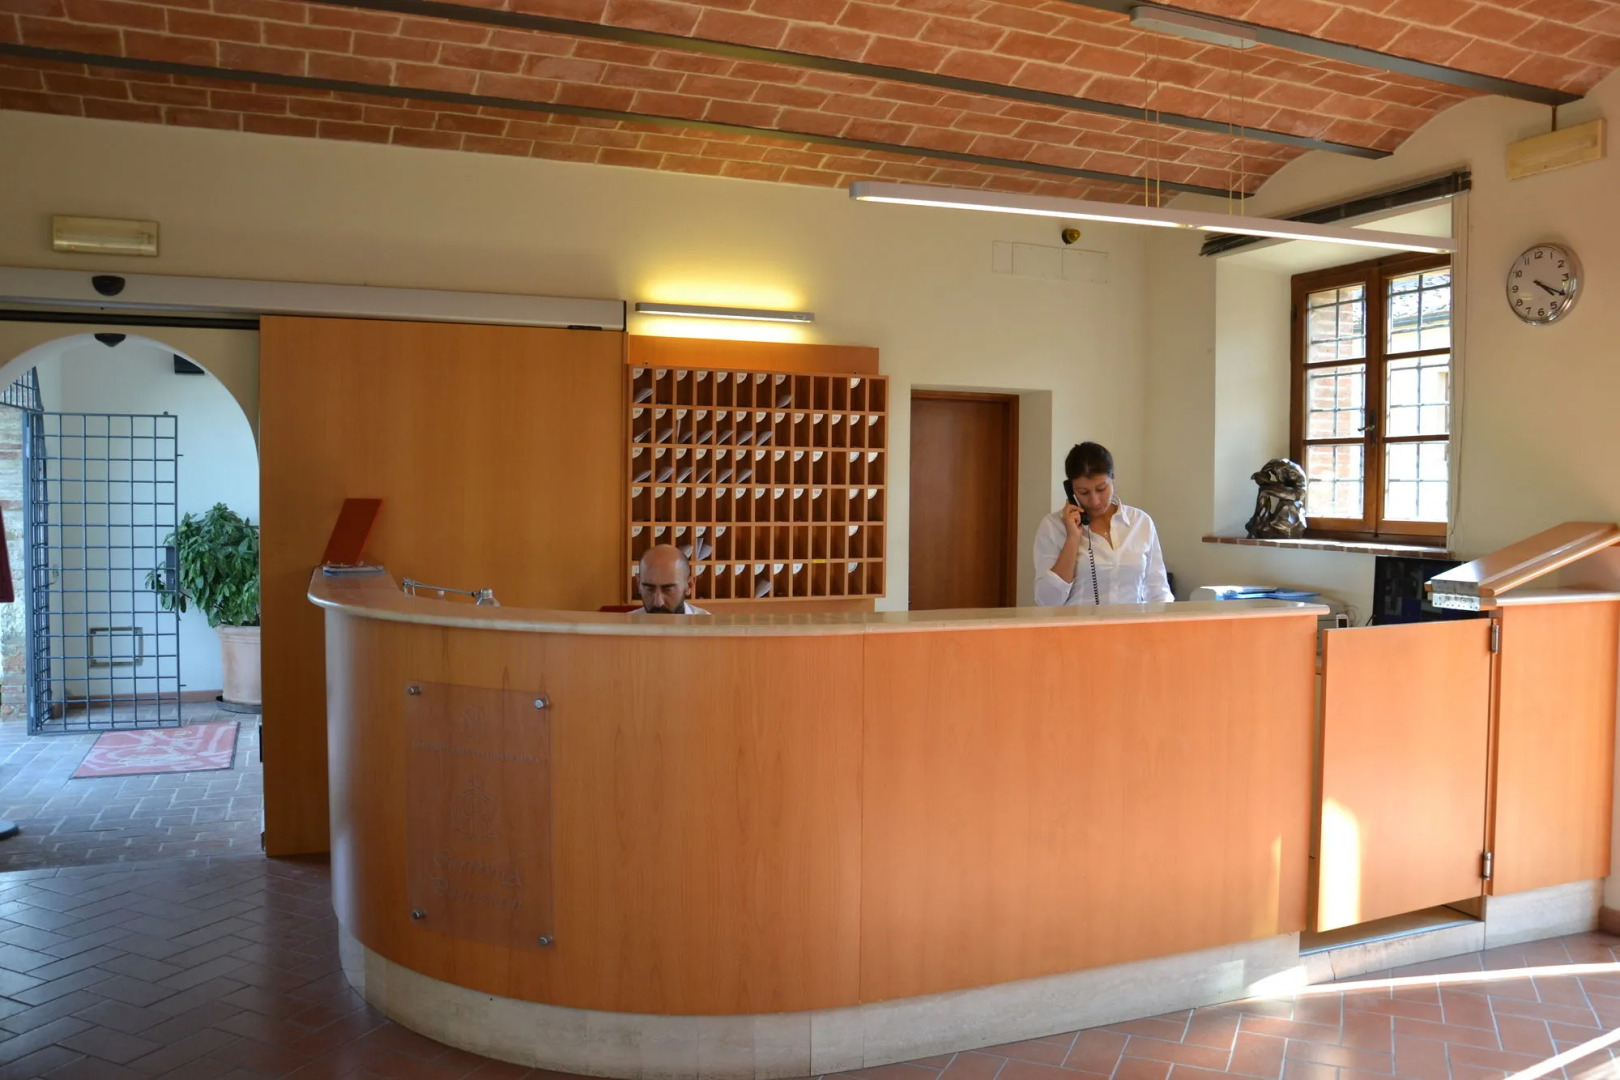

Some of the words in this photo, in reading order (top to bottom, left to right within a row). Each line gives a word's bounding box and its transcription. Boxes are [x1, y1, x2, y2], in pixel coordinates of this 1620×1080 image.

[1534, 251, 1543, 259] 12
[1524, 258, 1530, 266] 11
[1557, 259, 1564, 268] 2
[1515, 270, 1523, 278] 10
[1561, 273, 1569, 282] 3
[1512, 285, 1519, 293] 9
[1515, 299, 1523, 307] 8
[1550, 301, 1557, 310] 5
[1525, 307, 1532, 315] 7
[1538, 308, 1545, 316] 6
